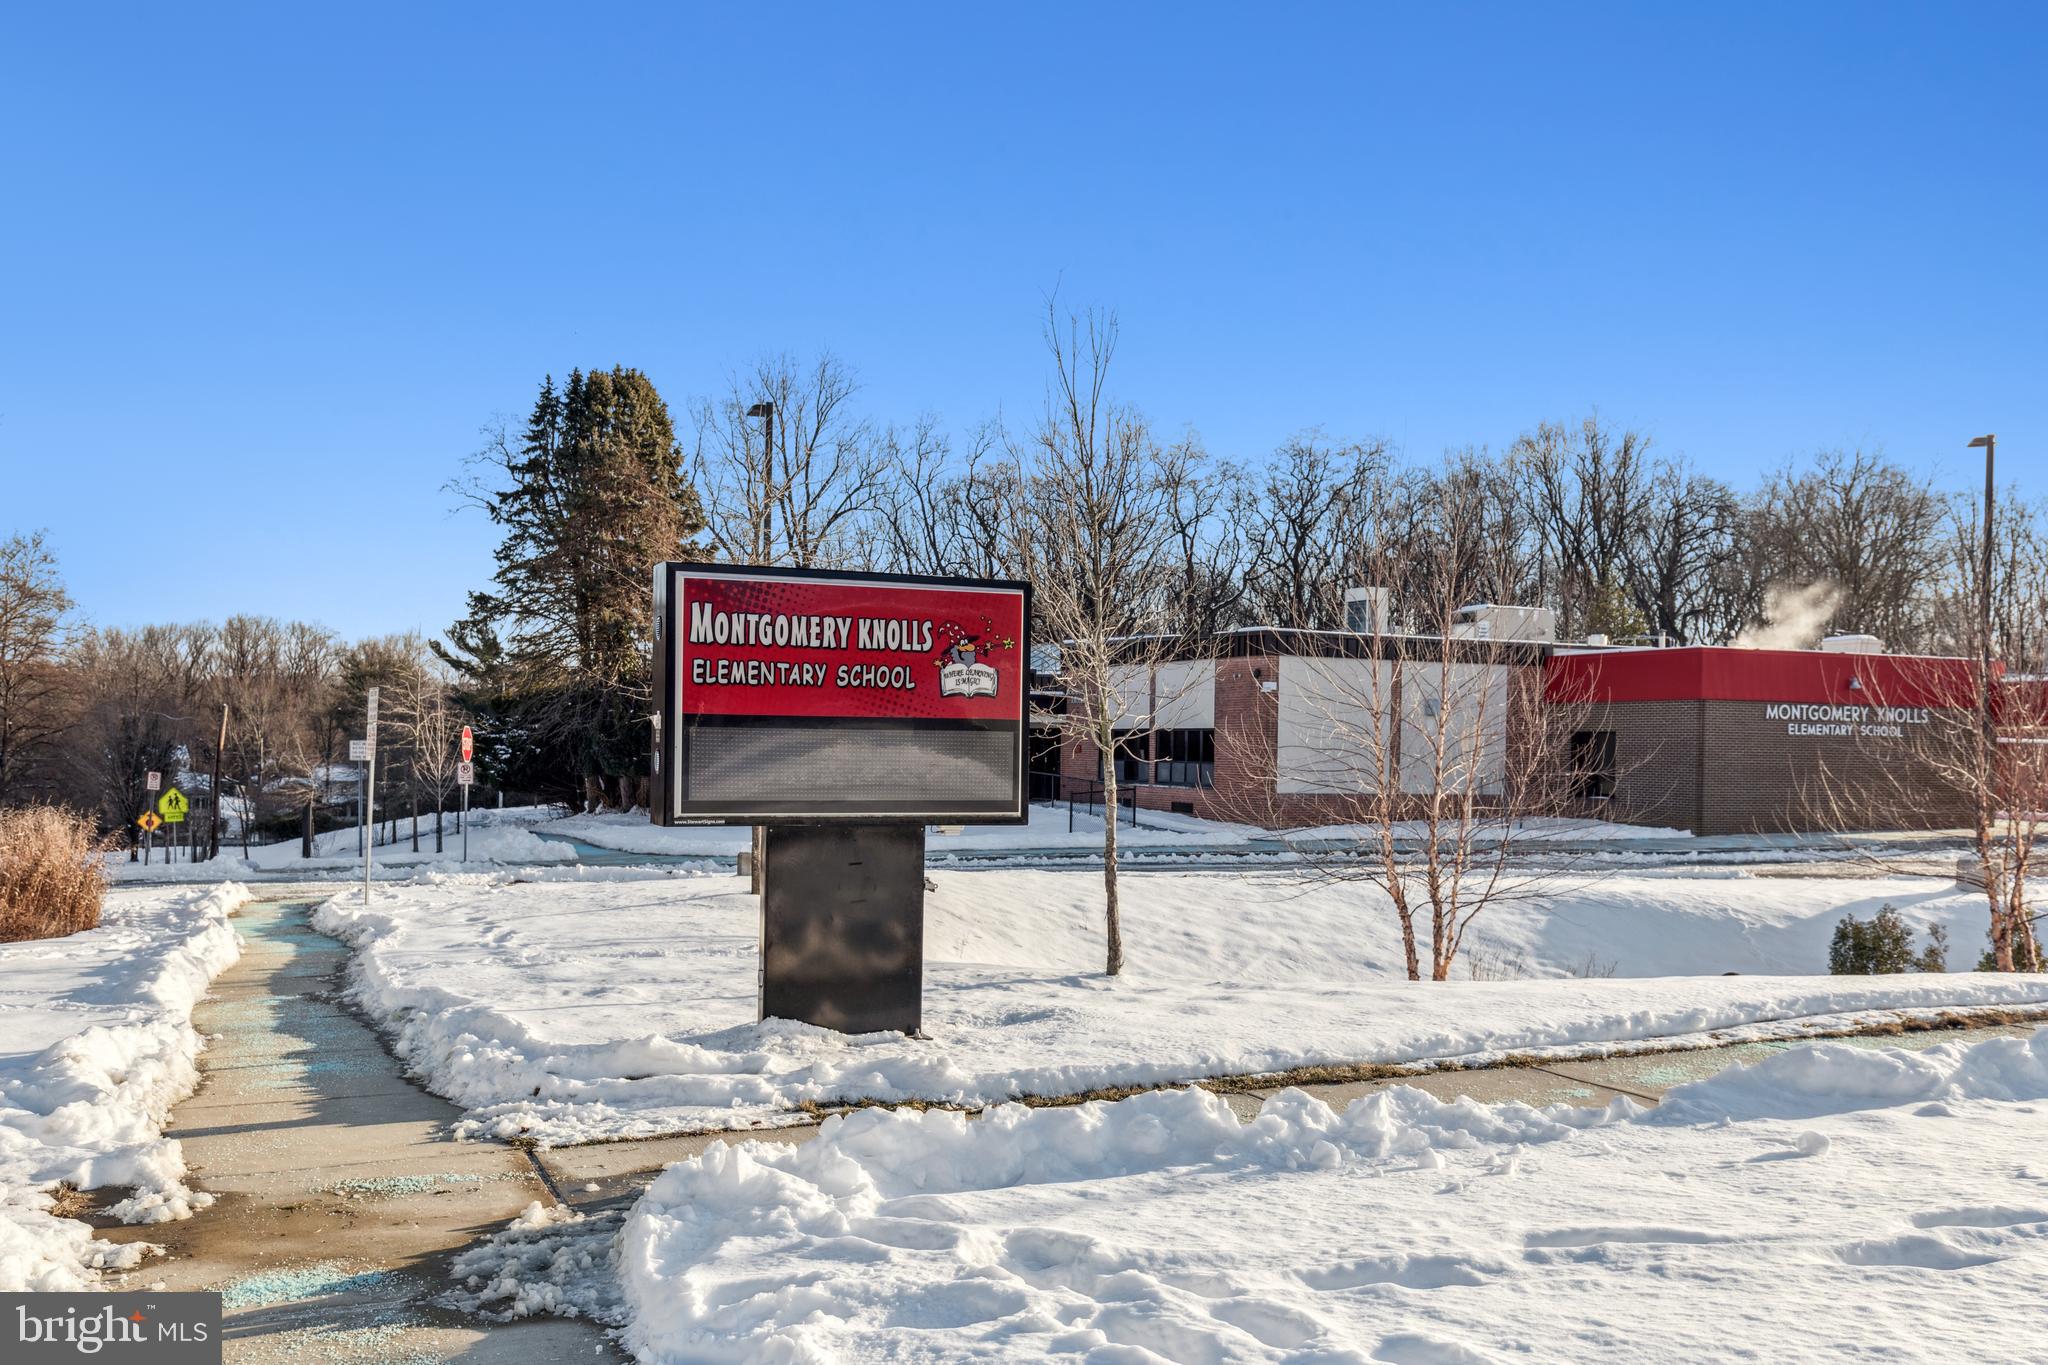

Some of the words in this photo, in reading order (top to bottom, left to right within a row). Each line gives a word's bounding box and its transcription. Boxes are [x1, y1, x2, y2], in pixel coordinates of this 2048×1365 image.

[689, 601, 852, 648] MONTGOMERY
[857, 617, 934, 652] KNOLLS
[692, 658, 827, 686] ELEMENTARY
[836, 665, 916, 689] SCHOOL
[1766, 704, 1869, 722] MONTGOMERY
[1877, 707, 1929, 724] KNOLLS
[1788, 723, 1853, 736] ELEMENTARY
[1860, 725, 1904, 738] SCHOOL
